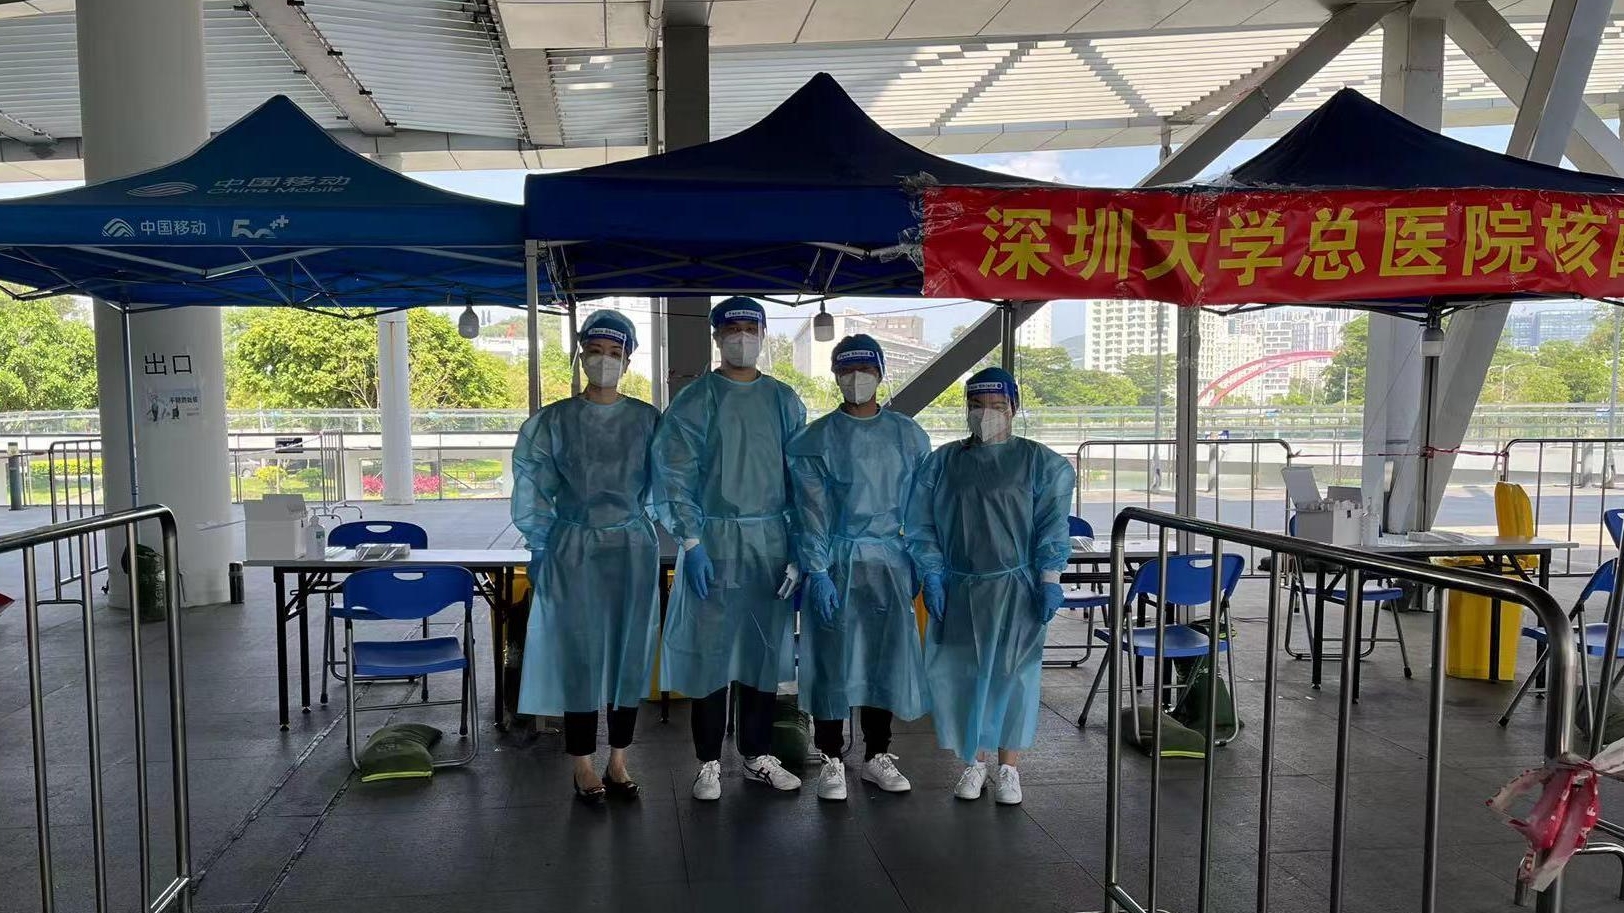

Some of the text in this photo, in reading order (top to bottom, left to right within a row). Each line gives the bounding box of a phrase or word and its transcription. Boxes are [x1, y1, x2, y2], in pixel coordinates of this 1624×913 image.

[214, 176, 350, 188] 中国移动
[140, 219, 207, 236] 中国移动
[144, 352, 192, 375] 出口
